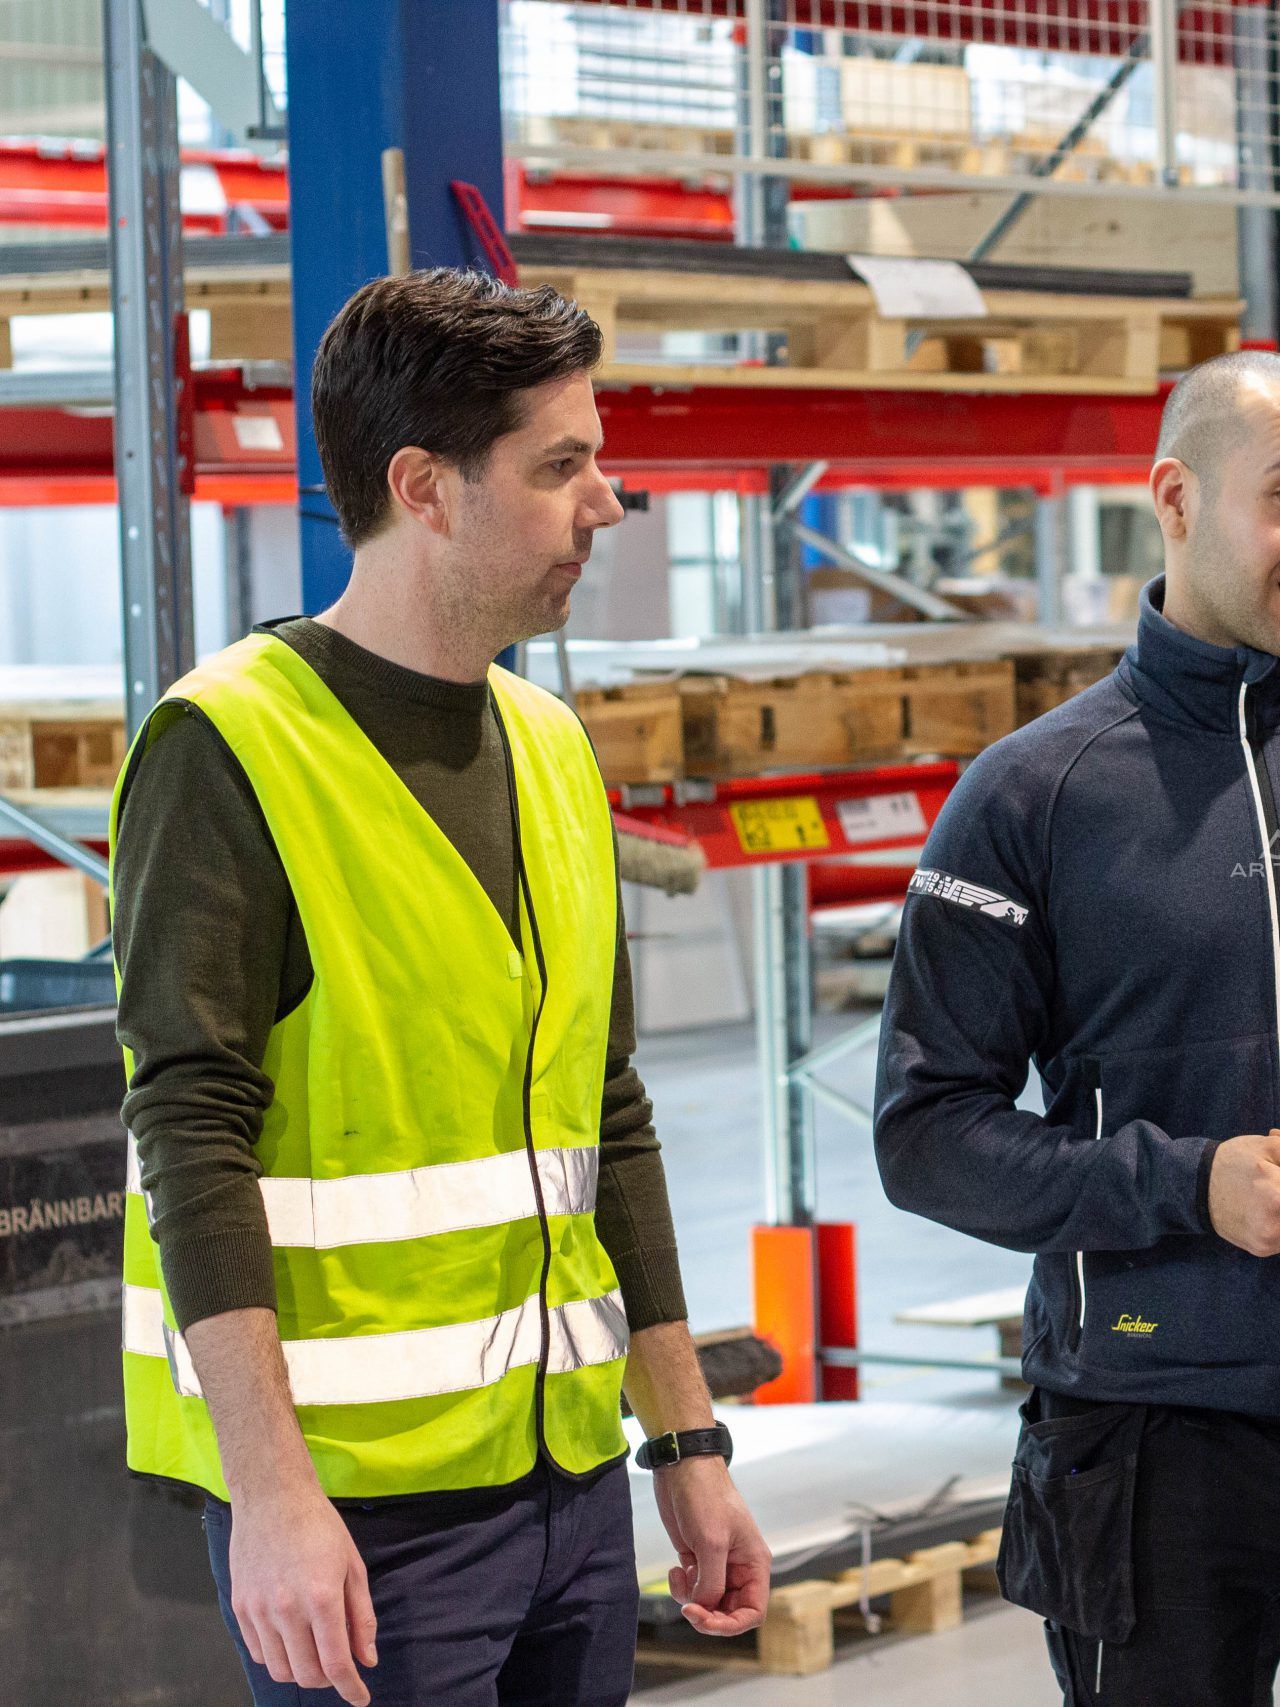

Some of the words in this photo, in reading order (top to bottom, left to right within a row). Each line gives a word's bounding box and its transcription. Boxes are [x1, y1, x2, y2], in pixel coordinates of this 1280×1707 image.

[927, 871, 940, 883] 19
[0, 1190, 126, 1237] BRÄNNBAR
[1111, 1314, 1159, 1333] Snickers
